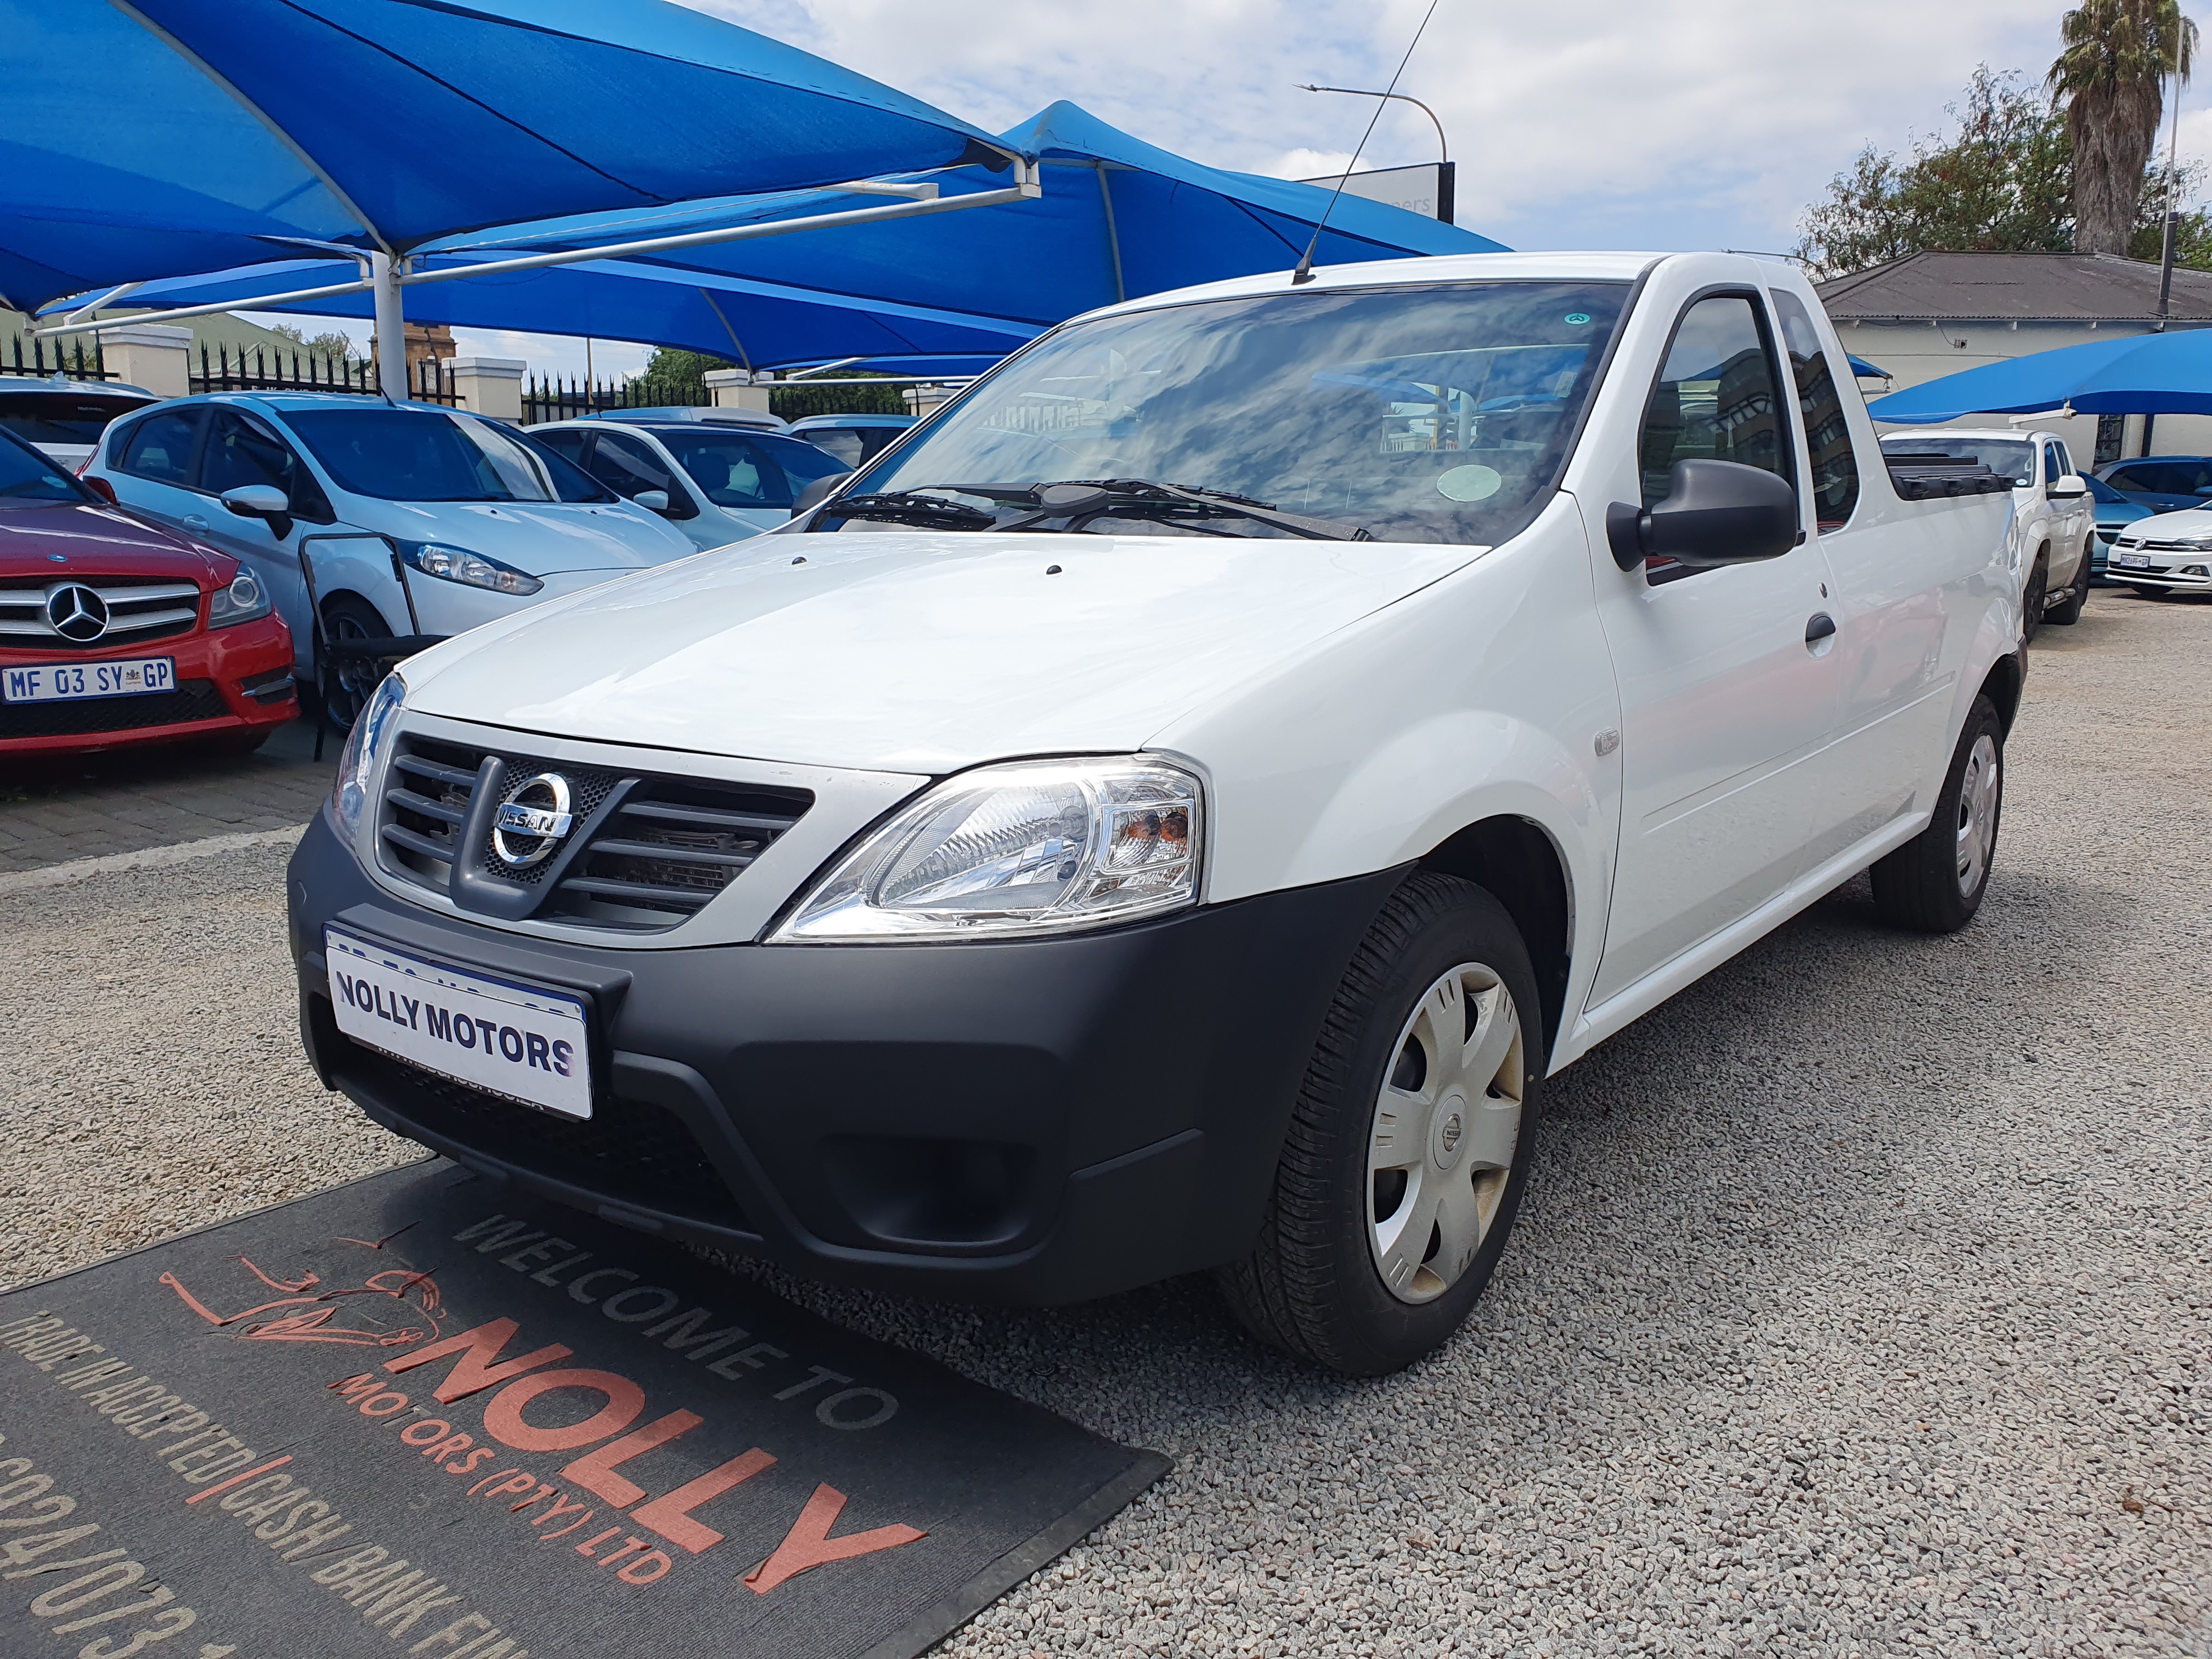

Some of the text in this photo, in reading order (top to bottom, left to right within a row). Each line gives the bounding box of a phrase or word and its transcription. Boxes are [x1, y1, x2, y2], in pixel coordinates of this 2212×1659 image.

[10, 662, 168, 697] MF 03 SY GP
[495, 806, 556, 832] NISSAN
[336, 970, 419, 1031] NOLLY
[425, 1003, 574, 1077] MOTORS
[452, 1214, 899, 1431] WELCOME TO
[326, 1372, 673, 1585] MOTORS (PTY) LTD
[382, 1317, 929, 1595] NOLLY
